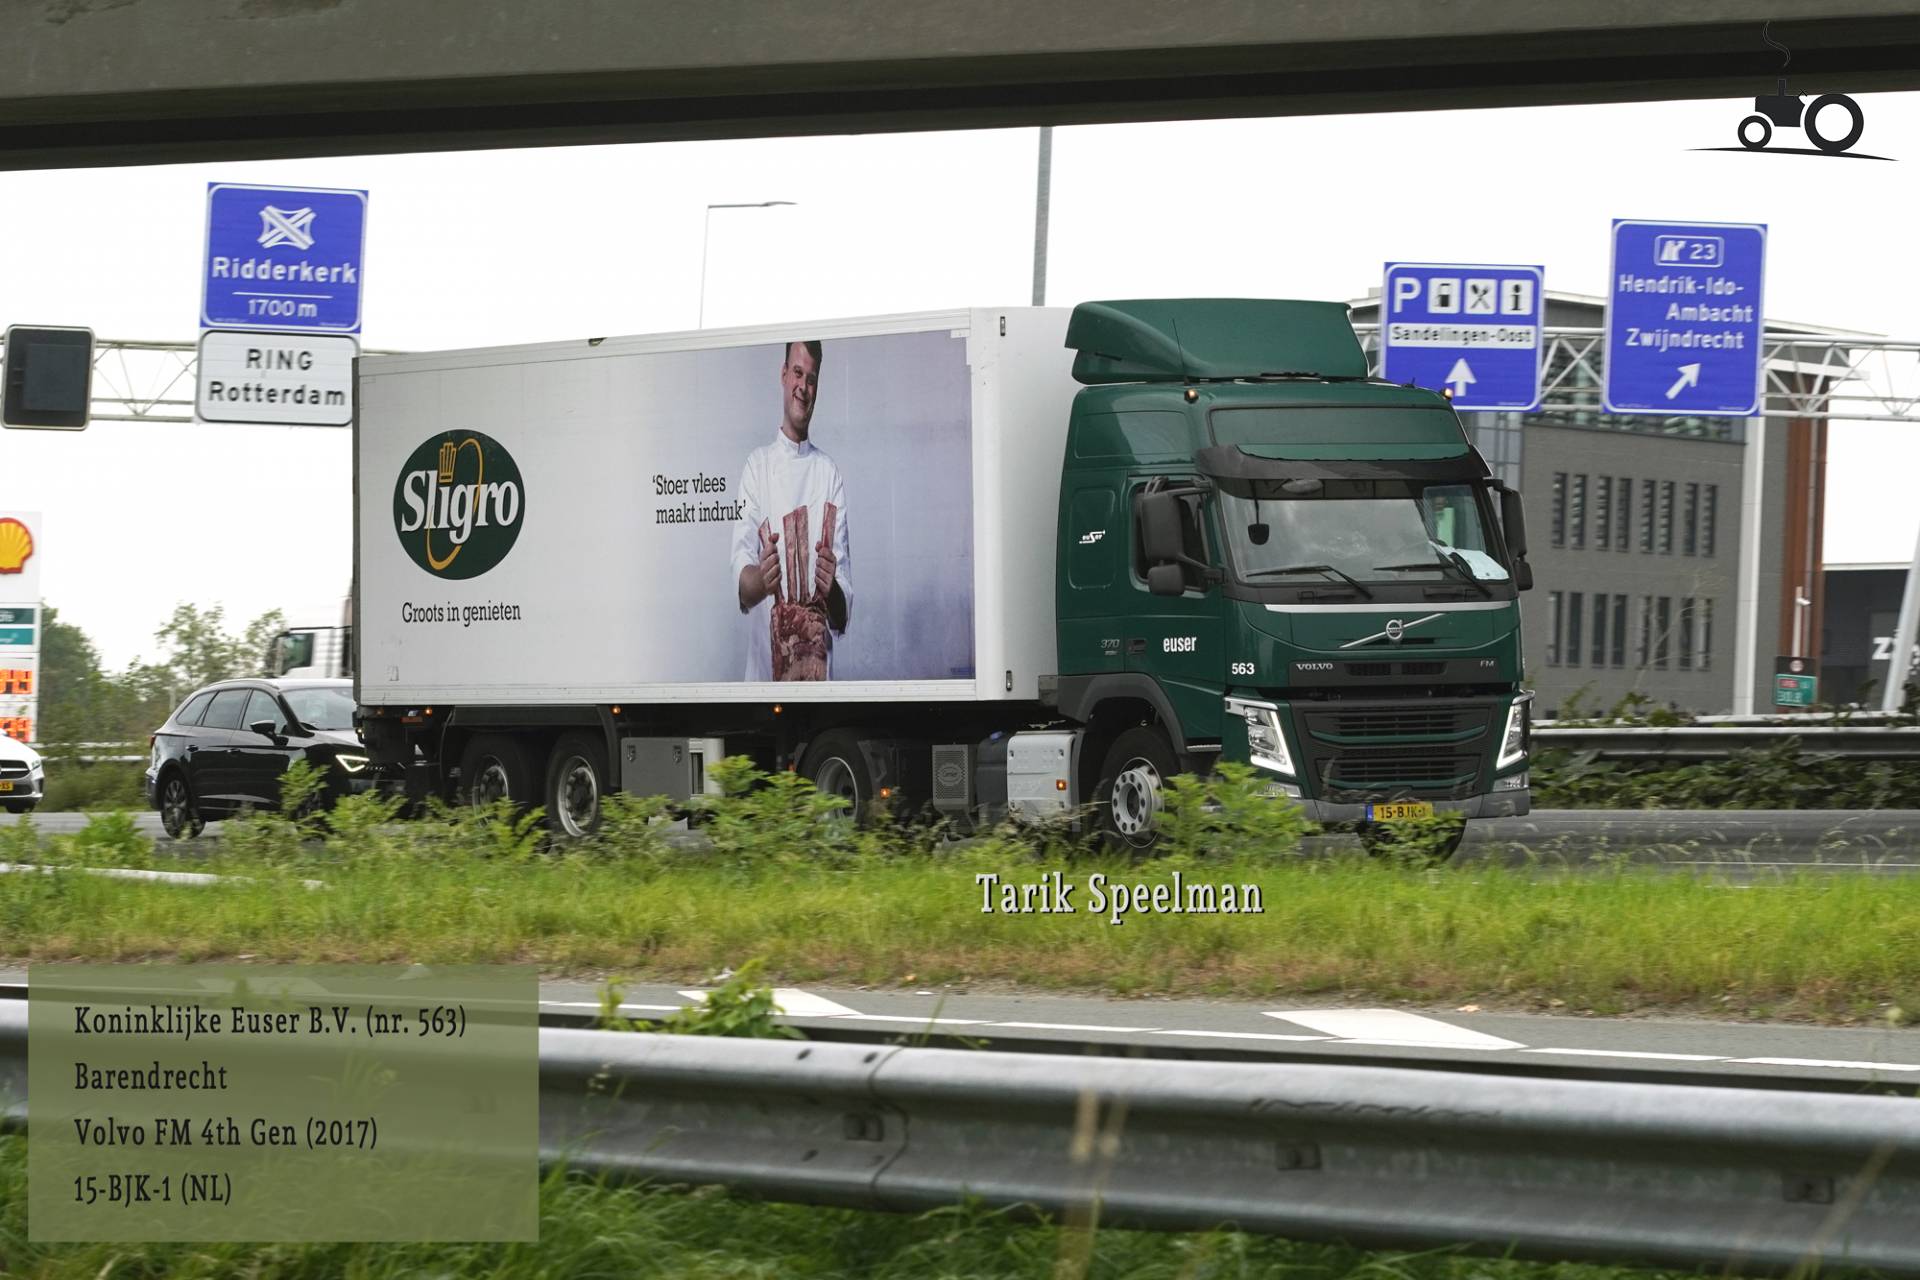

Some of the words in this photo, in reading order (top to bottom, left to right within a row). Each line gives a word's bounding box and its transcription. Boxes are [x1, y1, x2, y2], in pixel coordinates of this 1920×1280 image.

[1689, 243, 1717, 260] 23
[211, 256, 358, 284] Ridderkerk
[1618, 274, 1745, 296] Hendrik-Ido-
[248, 299, 296, 316] 1700
[1665, 302, 1753, 323] Ambacht
[1625, 328, 1745, 352] Zwijndrecht
[246, 348, 313, 371] RING
[209, 381, 346, 406] Rotterdam
[692, 472, 727, 494] vlees
[401, 469, 519, 545] Sligro
[655, 500, 695, 524] maakt
[402, 601, 444, 623] Groots
[447, 600, 460, 622] in
[462, 599, 522, 627] genieten
[1163, 636, 1197, 652] euser
[1231, 662, 1255, 675] 563
[1296, 662, 1334, 671] VOLVO
[1480, 659, 1495, 667] FM
